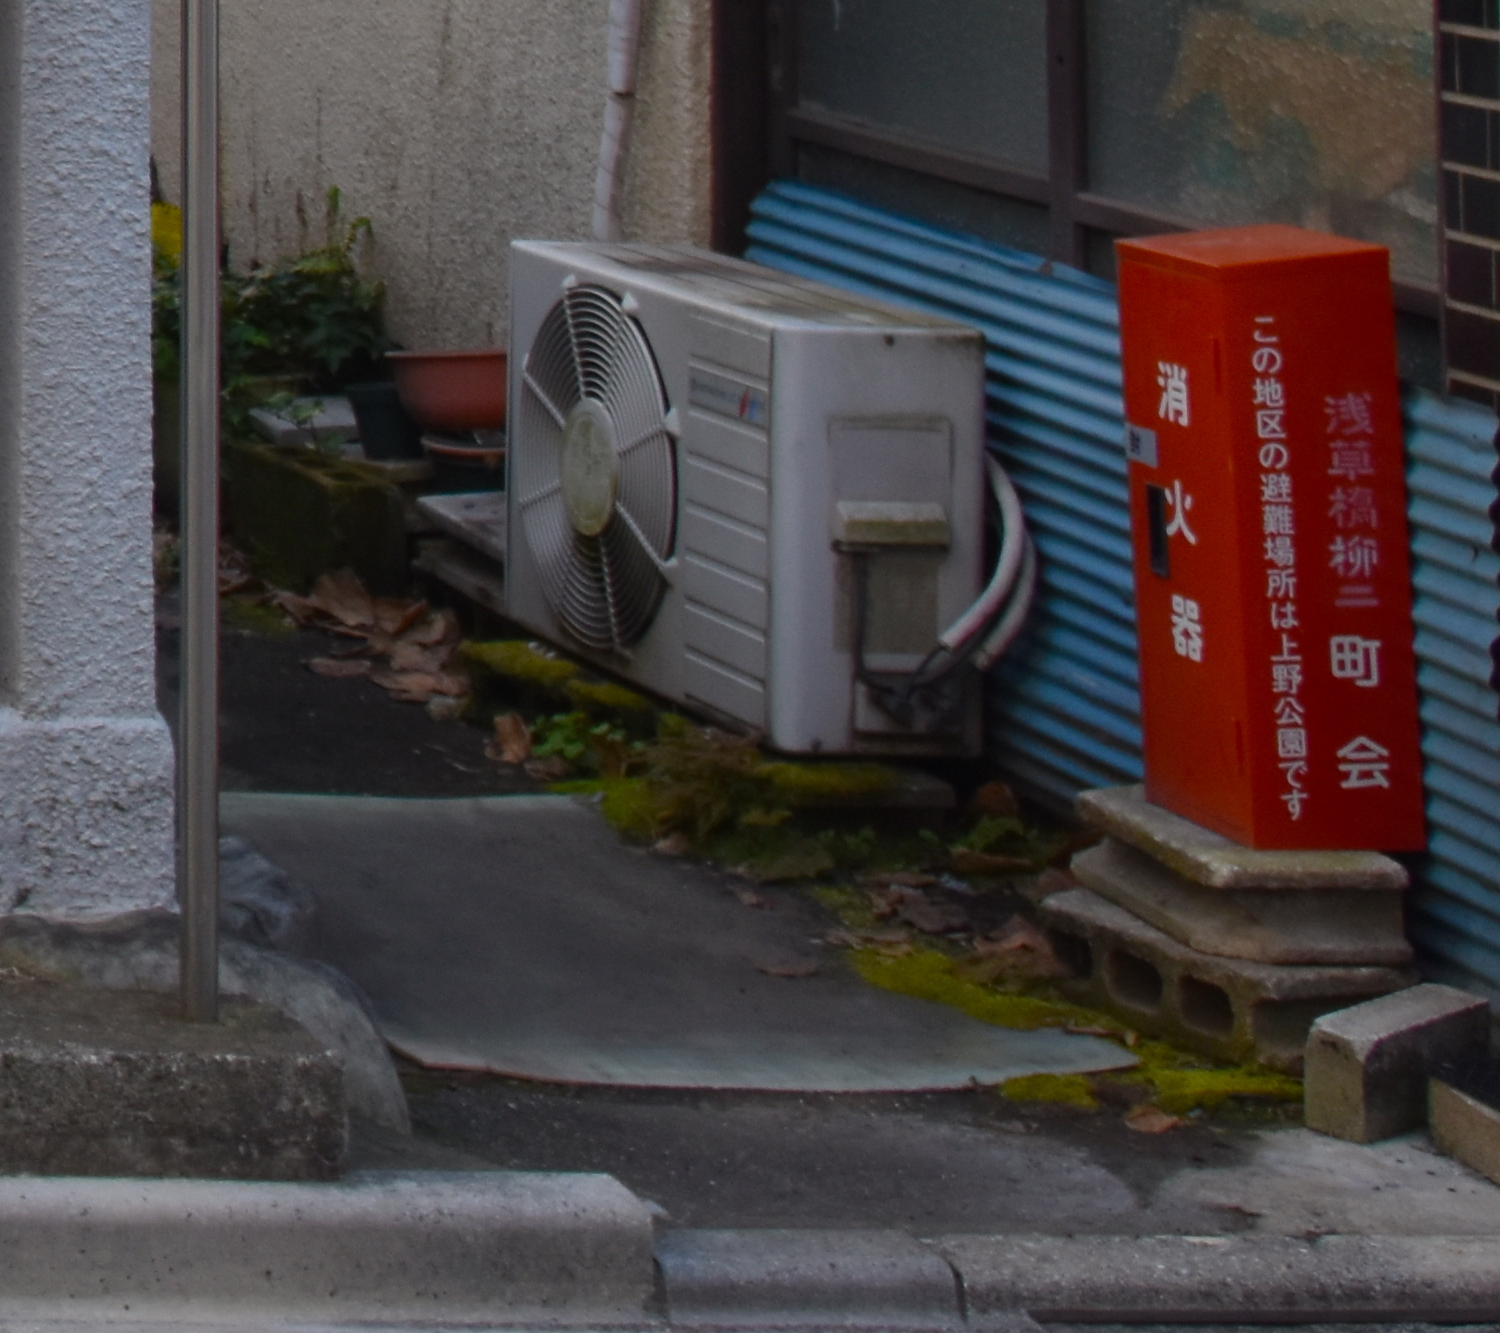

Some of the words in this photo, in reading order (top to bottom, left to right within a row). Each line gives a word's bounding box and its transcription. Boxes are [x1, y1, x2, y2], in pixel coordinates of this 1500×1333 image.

[1156, 361, 1206, 664] 消火器
[1252, 315, 1308, 822] この地区の避難場所は上野公園です
